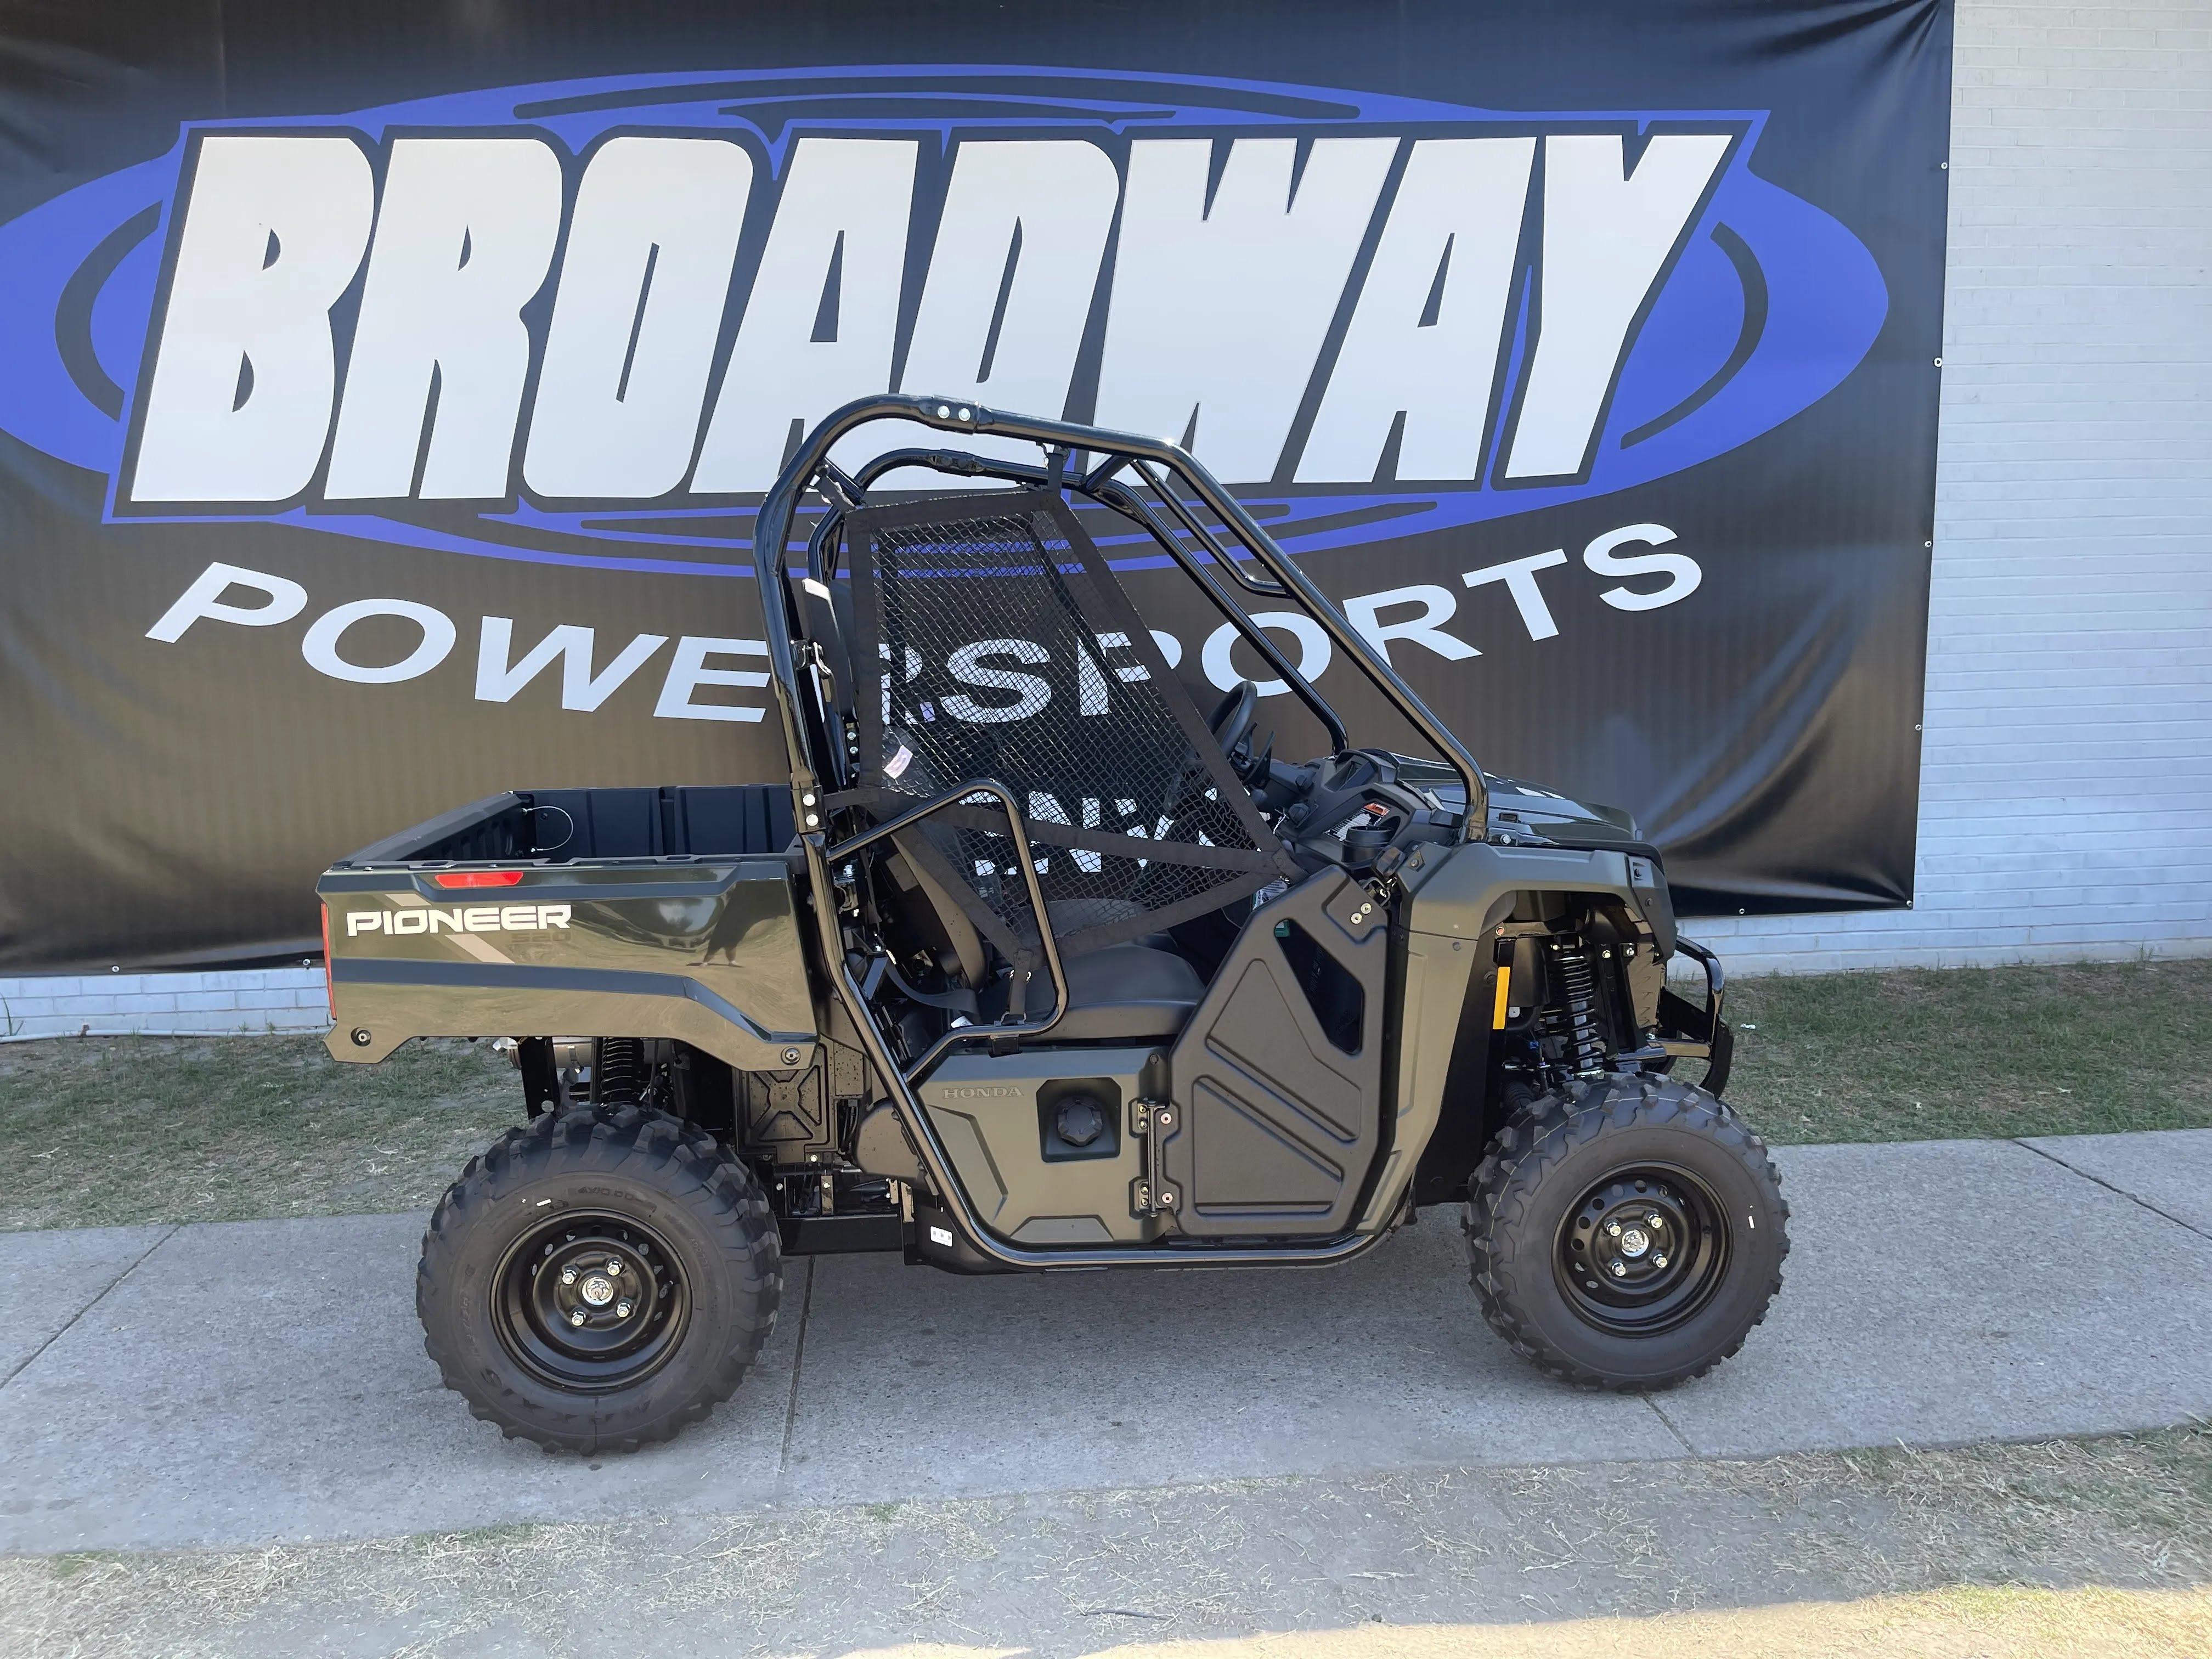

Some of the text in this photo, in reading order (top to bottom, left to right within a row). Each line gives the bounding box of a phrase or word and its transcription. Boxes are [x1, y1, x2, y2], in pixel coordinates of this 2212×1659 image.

[131, 134, 1733, 502] BROADWAY
[346, 904, 572, 936] PIONEER
[511, 930, 572, 943] 520
[942, 1086, 1025, 1099] HONDA
